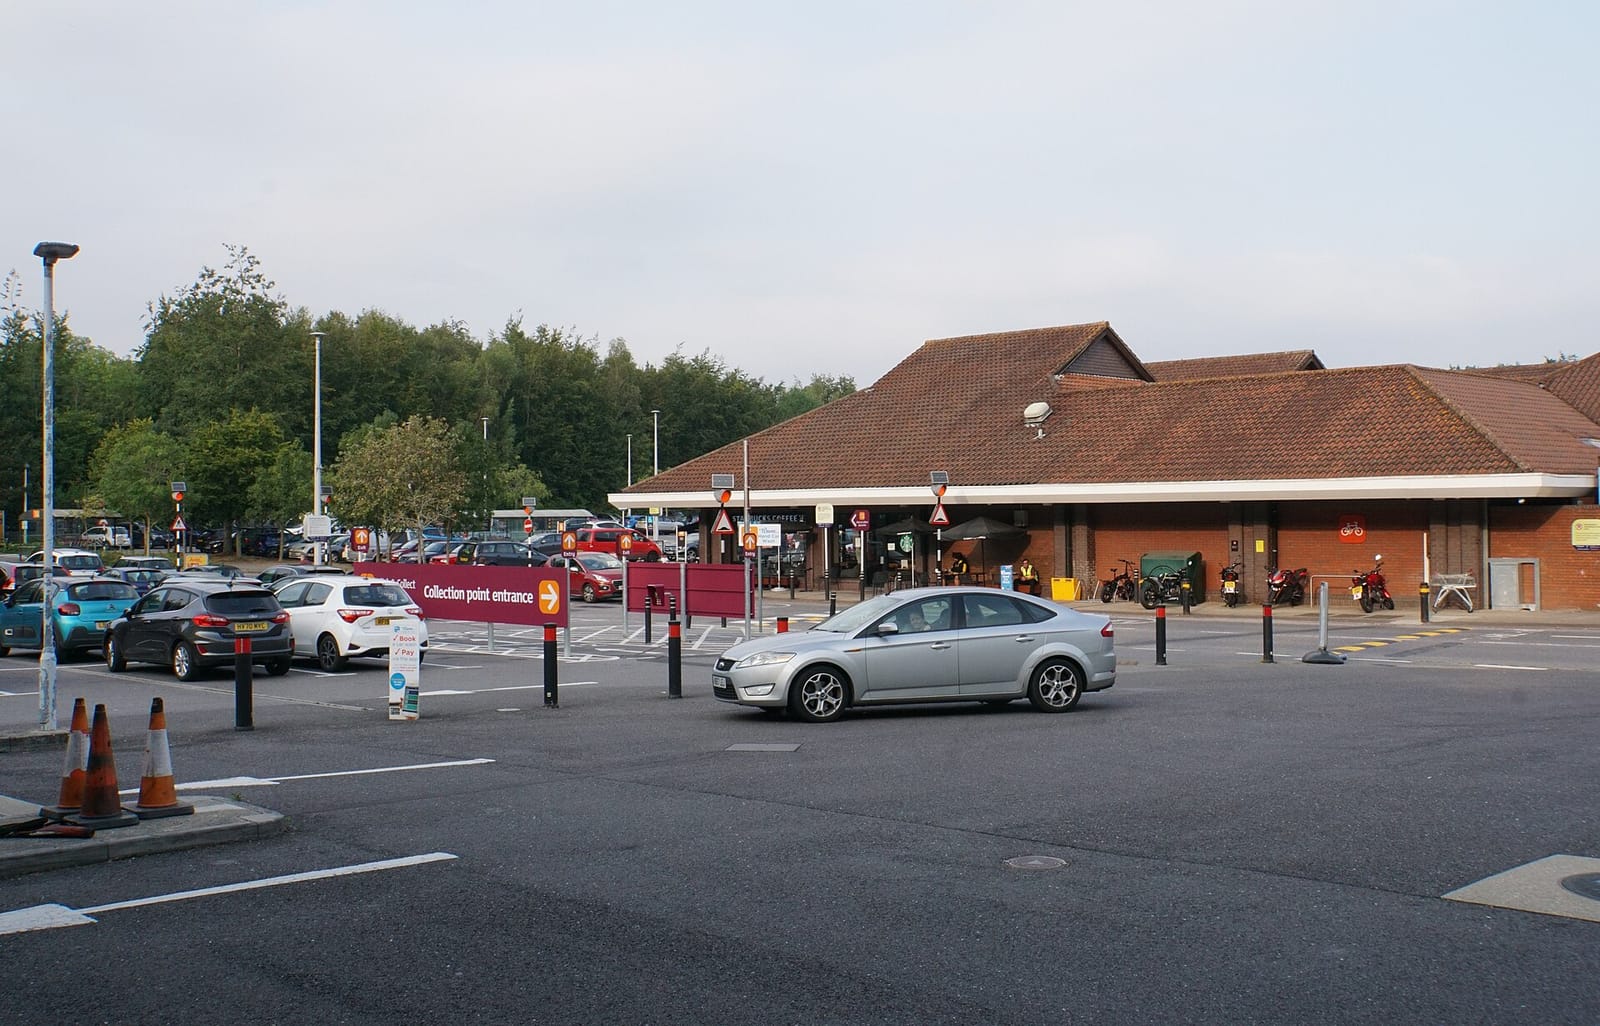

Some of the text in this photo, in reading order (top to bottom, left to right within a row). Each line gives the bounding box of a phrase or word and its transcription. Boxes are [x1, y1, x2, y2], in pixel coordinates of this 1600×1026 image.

[424, 585, 534, 604] Collection point entrance
